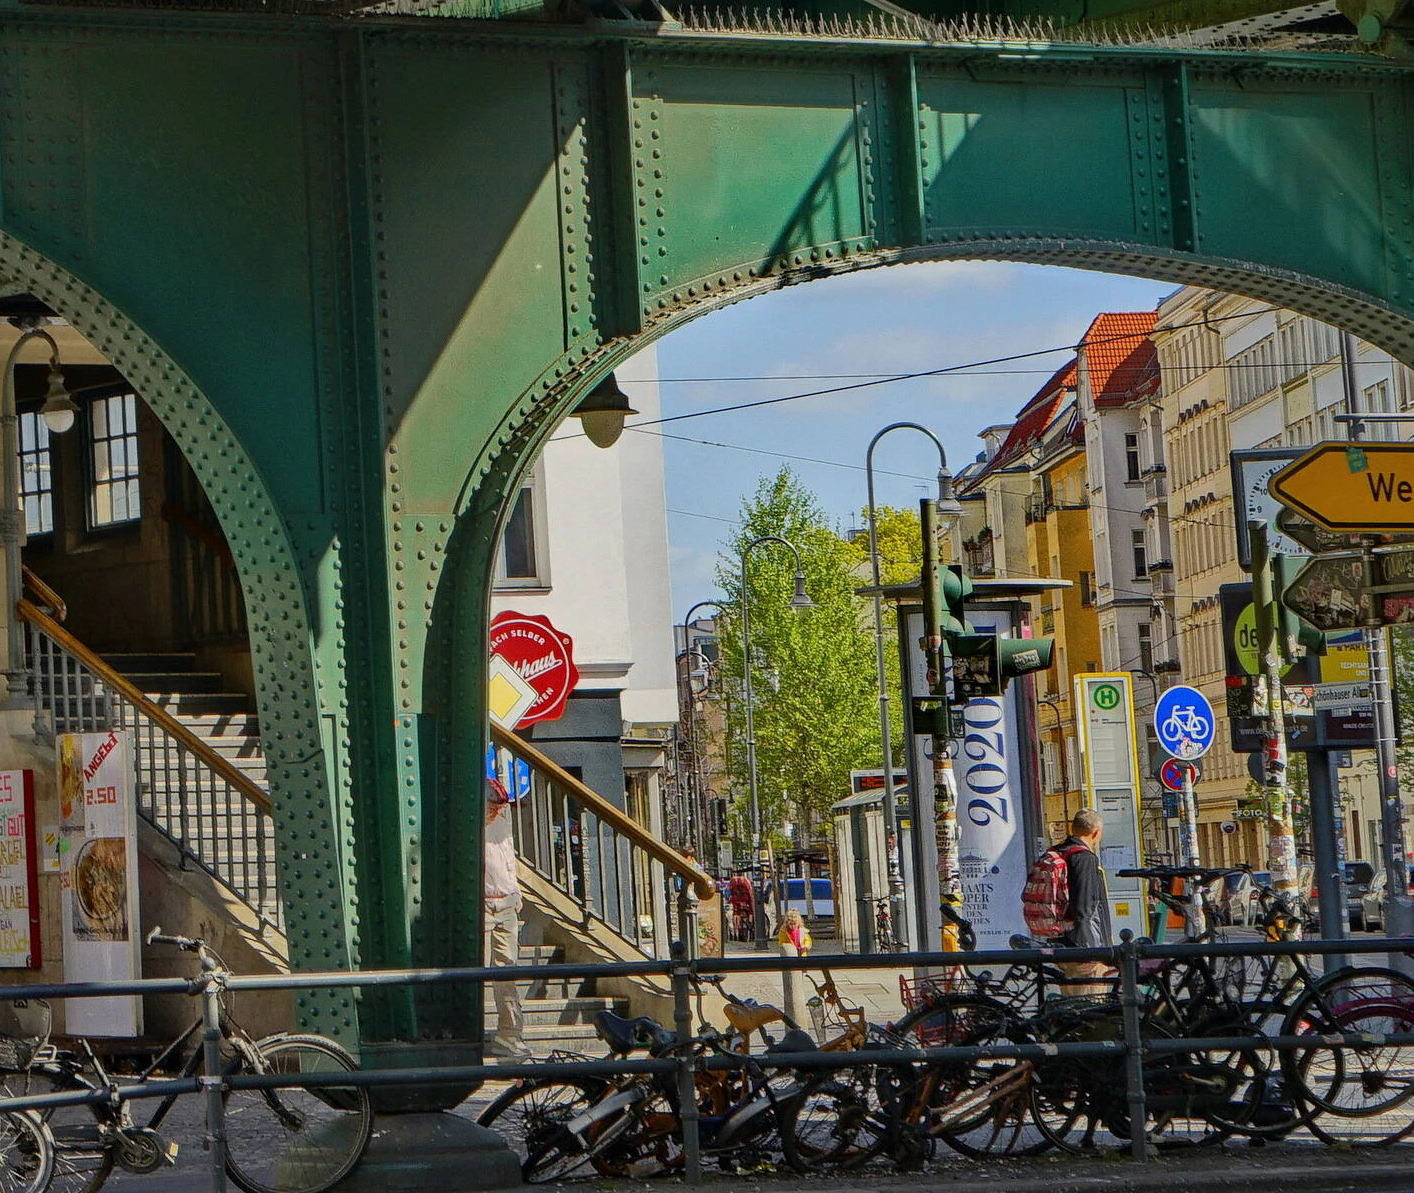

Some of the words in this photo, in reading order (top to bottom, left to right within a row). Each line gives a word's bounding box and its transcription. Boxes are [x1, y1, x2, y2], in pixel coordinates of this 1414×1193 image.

[1256, 505, 1263, 514] 9
[510, 629, 547, 647] SELBER
[963, 696, 1009, 827] 2020
[85, 786, 117, 806] 2.50
